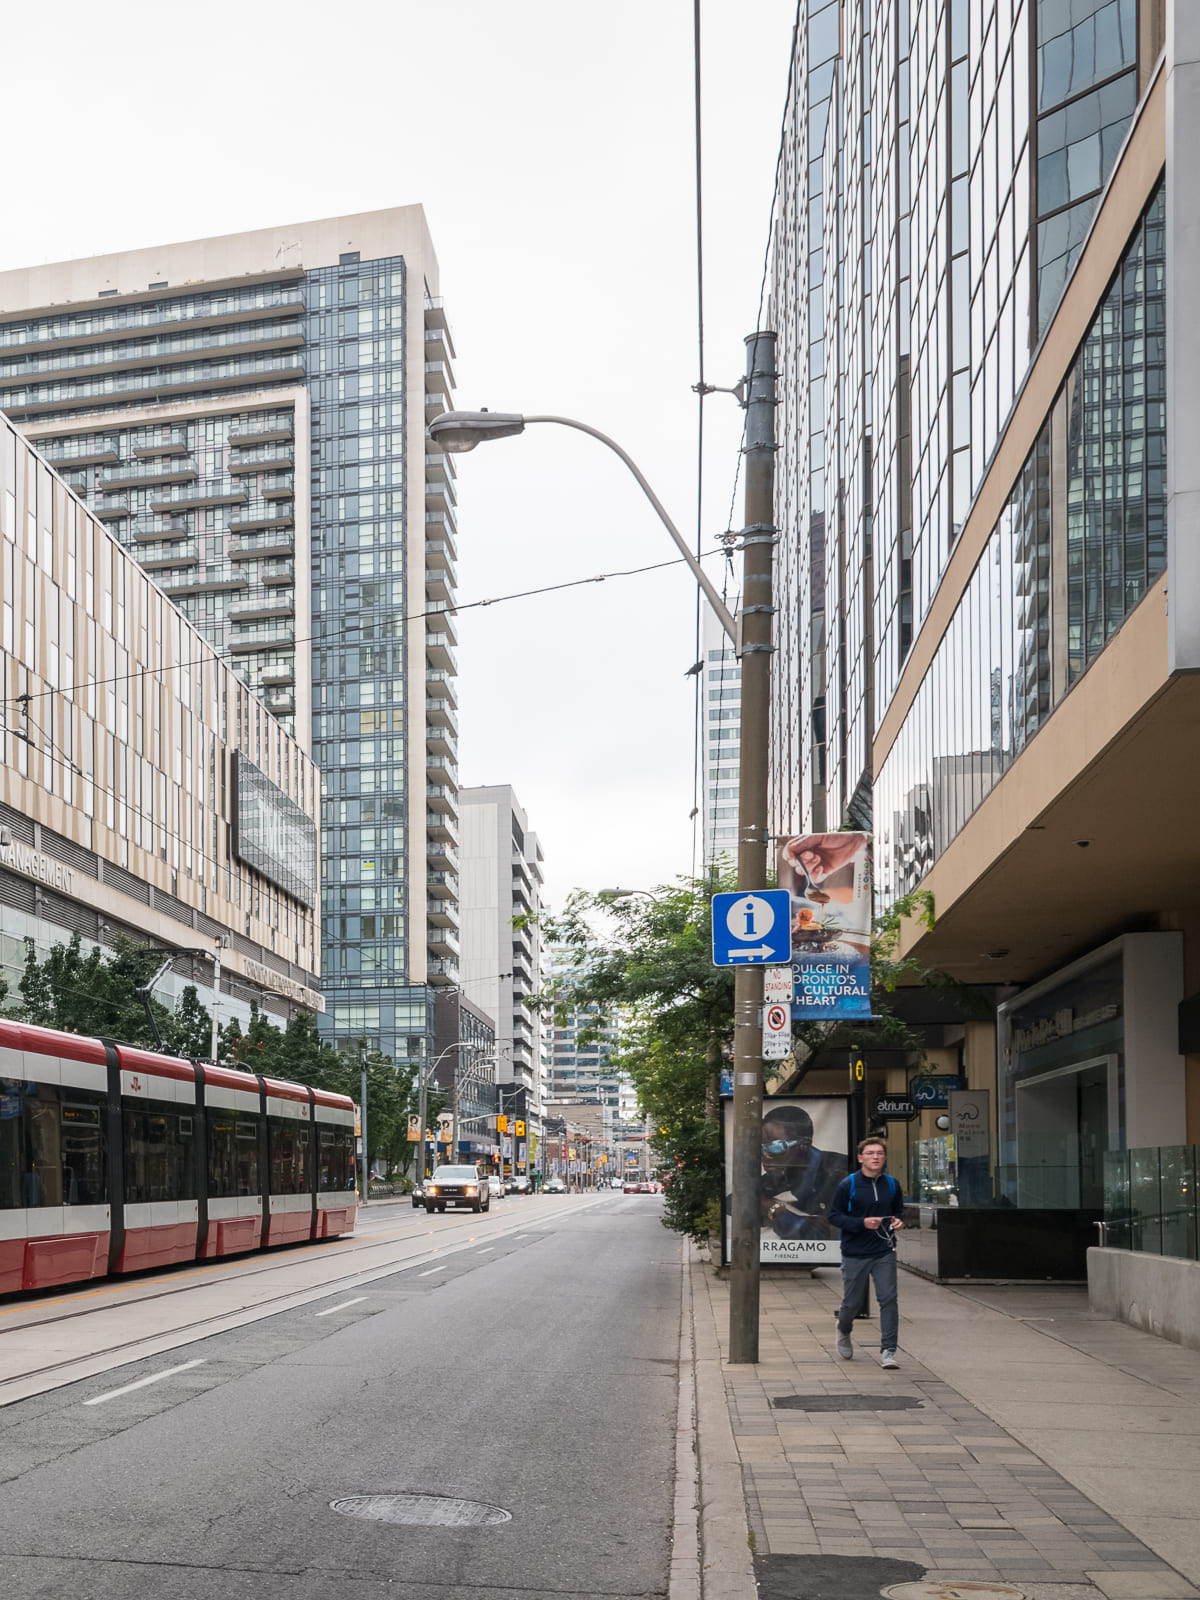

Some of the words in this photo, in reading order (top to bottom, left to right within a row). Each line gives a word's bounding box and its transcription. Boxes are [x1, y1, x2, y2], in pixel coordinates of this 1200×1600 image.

[785, 964, 832, 974] DULGE
[835, 963, 850, 974] IN
[772, 970, 782, 980] NO
[793, 974, 857, 985] ORONTO'S
[765, 980, 792, 992] STANDING
[803, 985, 868, 996] CULTURAL
[796, 996, 837, 1006] HEART
[877, 1100, 914, 1111] atrium
[761, 1241, 827, 1252] RRAGAMO
